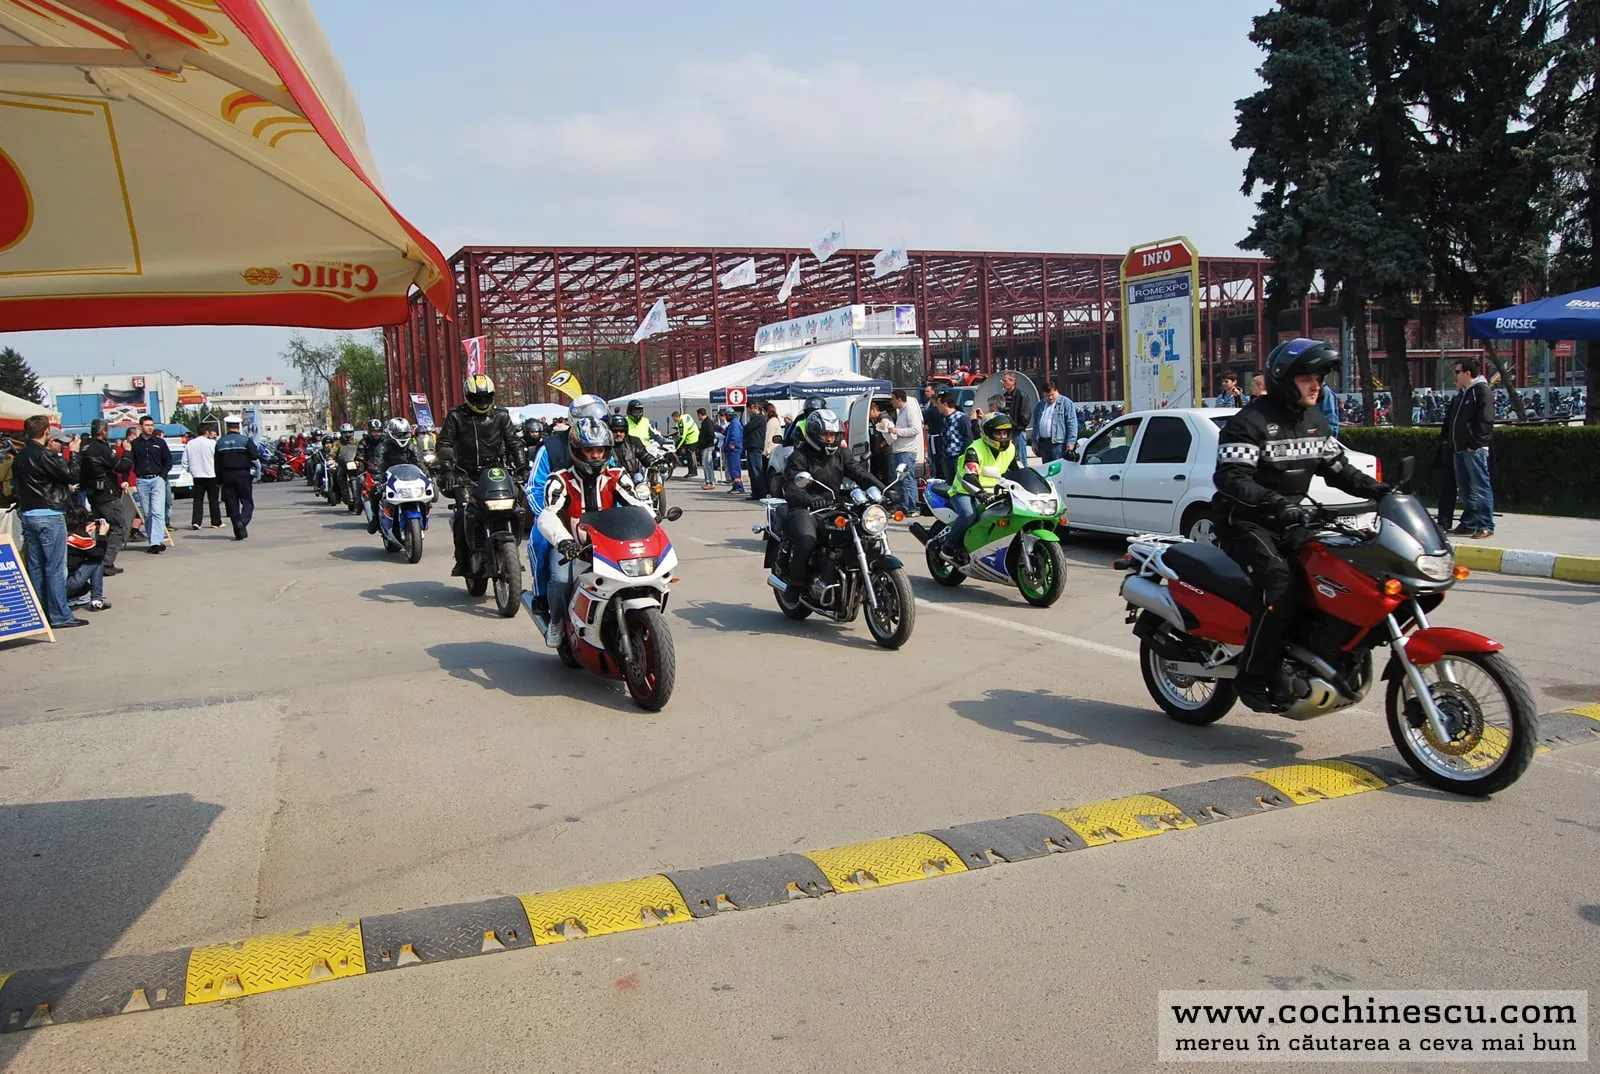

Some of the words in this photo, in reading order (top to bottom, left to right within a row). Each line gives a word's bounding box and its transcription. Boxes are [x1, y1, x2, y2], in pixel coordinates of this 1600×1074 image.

[1142, 249, 1171, 266] INFO
[1135, 282, 1188, 297] ROMEXPO
[1495, 317, 1537, 329] BORSEC
[133, 379, 144, 387] 15
[1180, 581, 1204, 594] 650
